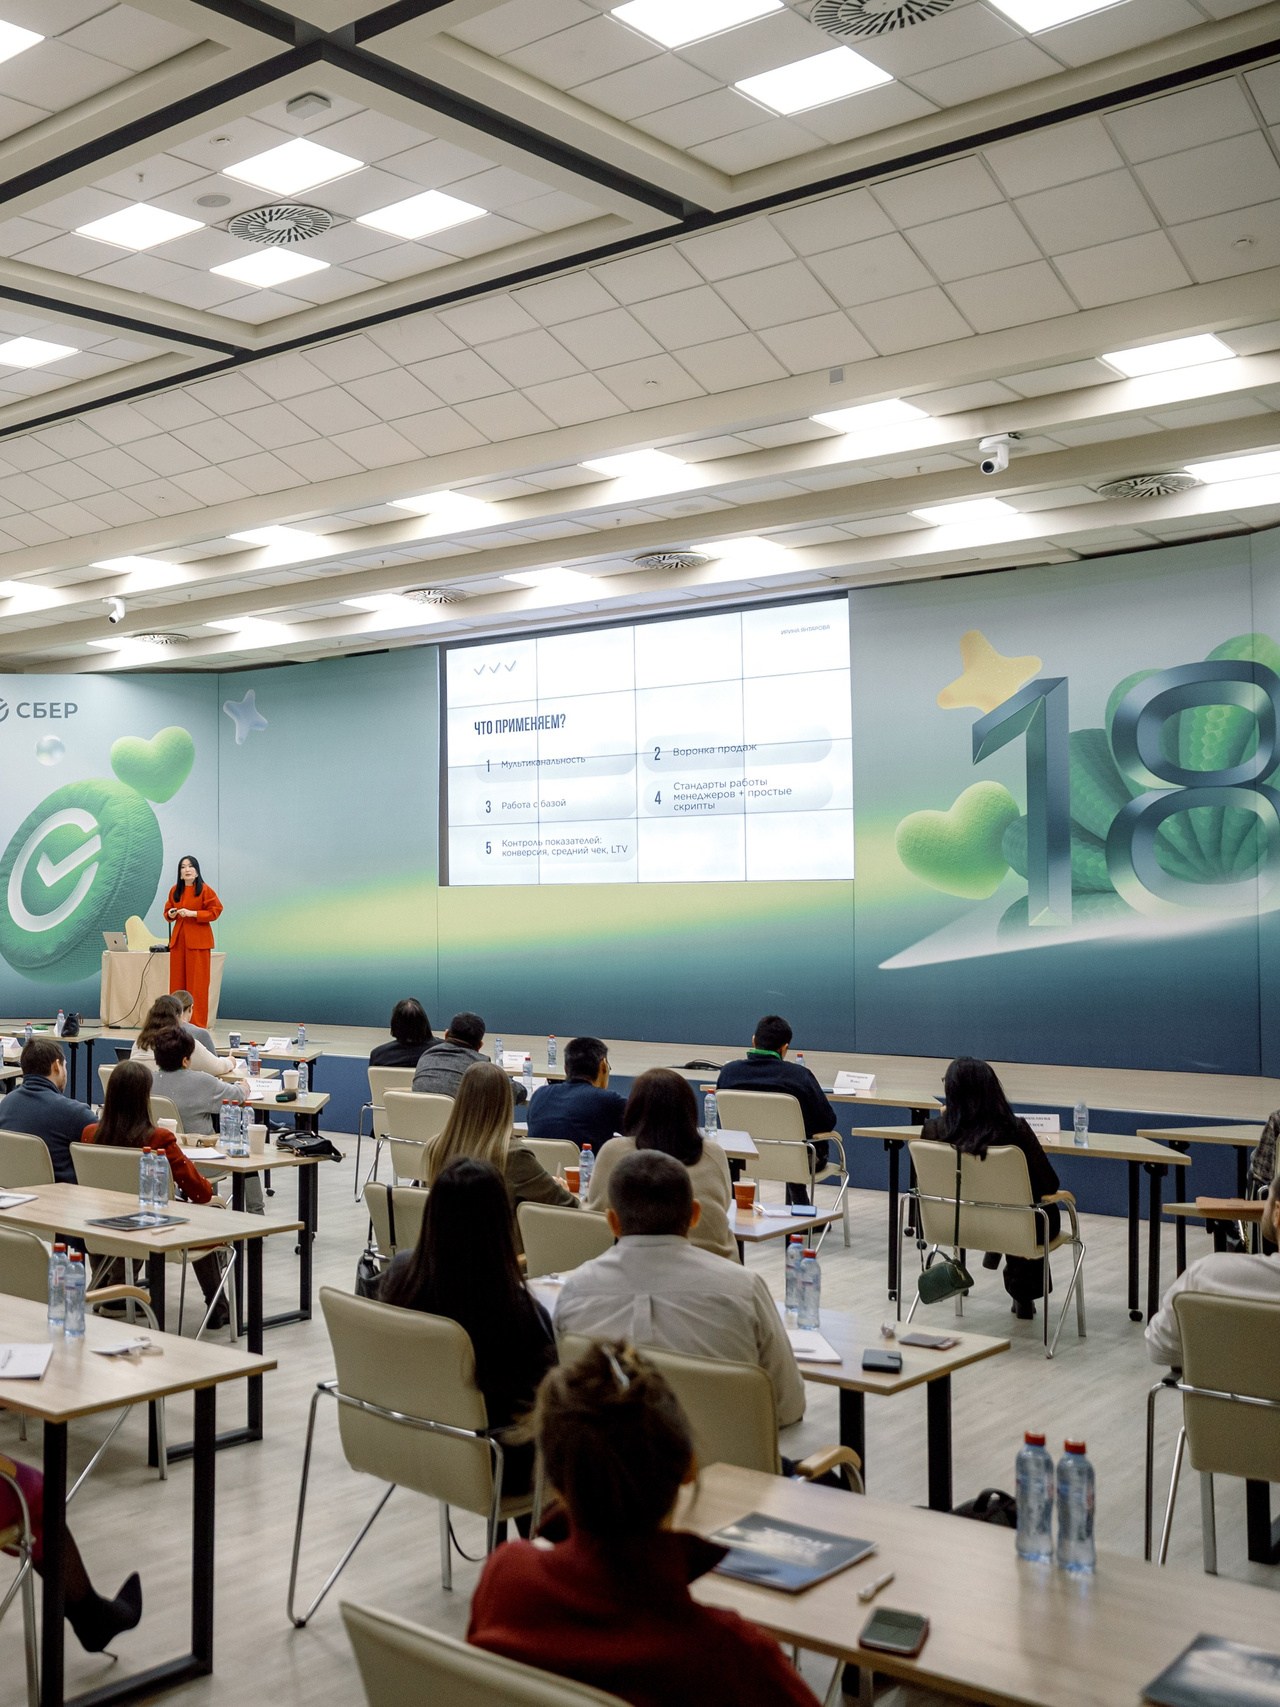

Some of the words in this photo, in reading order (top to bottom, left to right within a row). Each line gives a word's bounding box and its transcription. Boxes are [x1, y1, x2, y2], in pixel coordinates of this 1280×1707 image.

[16, 702, 79, 719] СБЕР
[474, 720, 493, 735] ЧТО
[495, 713, 566, 734] ПРИМЕНЯЕМ?
[654, 746, 661, 761] 2
[673, 746, 715, 757] Воронка
[717, 743, 757, 754] продаж
[486, 759, 491, 772] 1
[501, 756, 586, 769] Мультиканальность
[673, 781, 727, 791] Стандарты
[729, 777, 768, 789] работы
[654, 790, 662, 805] 4
[673, 791, 736, 801] менеджеров
[747, 787, 793, 798] простые
[972, 659, 1280, 927] 18
[485, 800, 492, 814] 3
[501, 801, 531, 810] Работа
[540, 798, 567, 808] базой
[673, 802, 716, 812] скрипты
[485, 841, 492, 855] 5
[501, 839, 543, 848] Контроль
[545, 836, 602, 847] показателей:
[501, 848, 550, 858] конверсия,
[551, 845, 589, 857] средний
[591, 845, 609, 855] чек,
[611, 845, 628, 854] LTV
